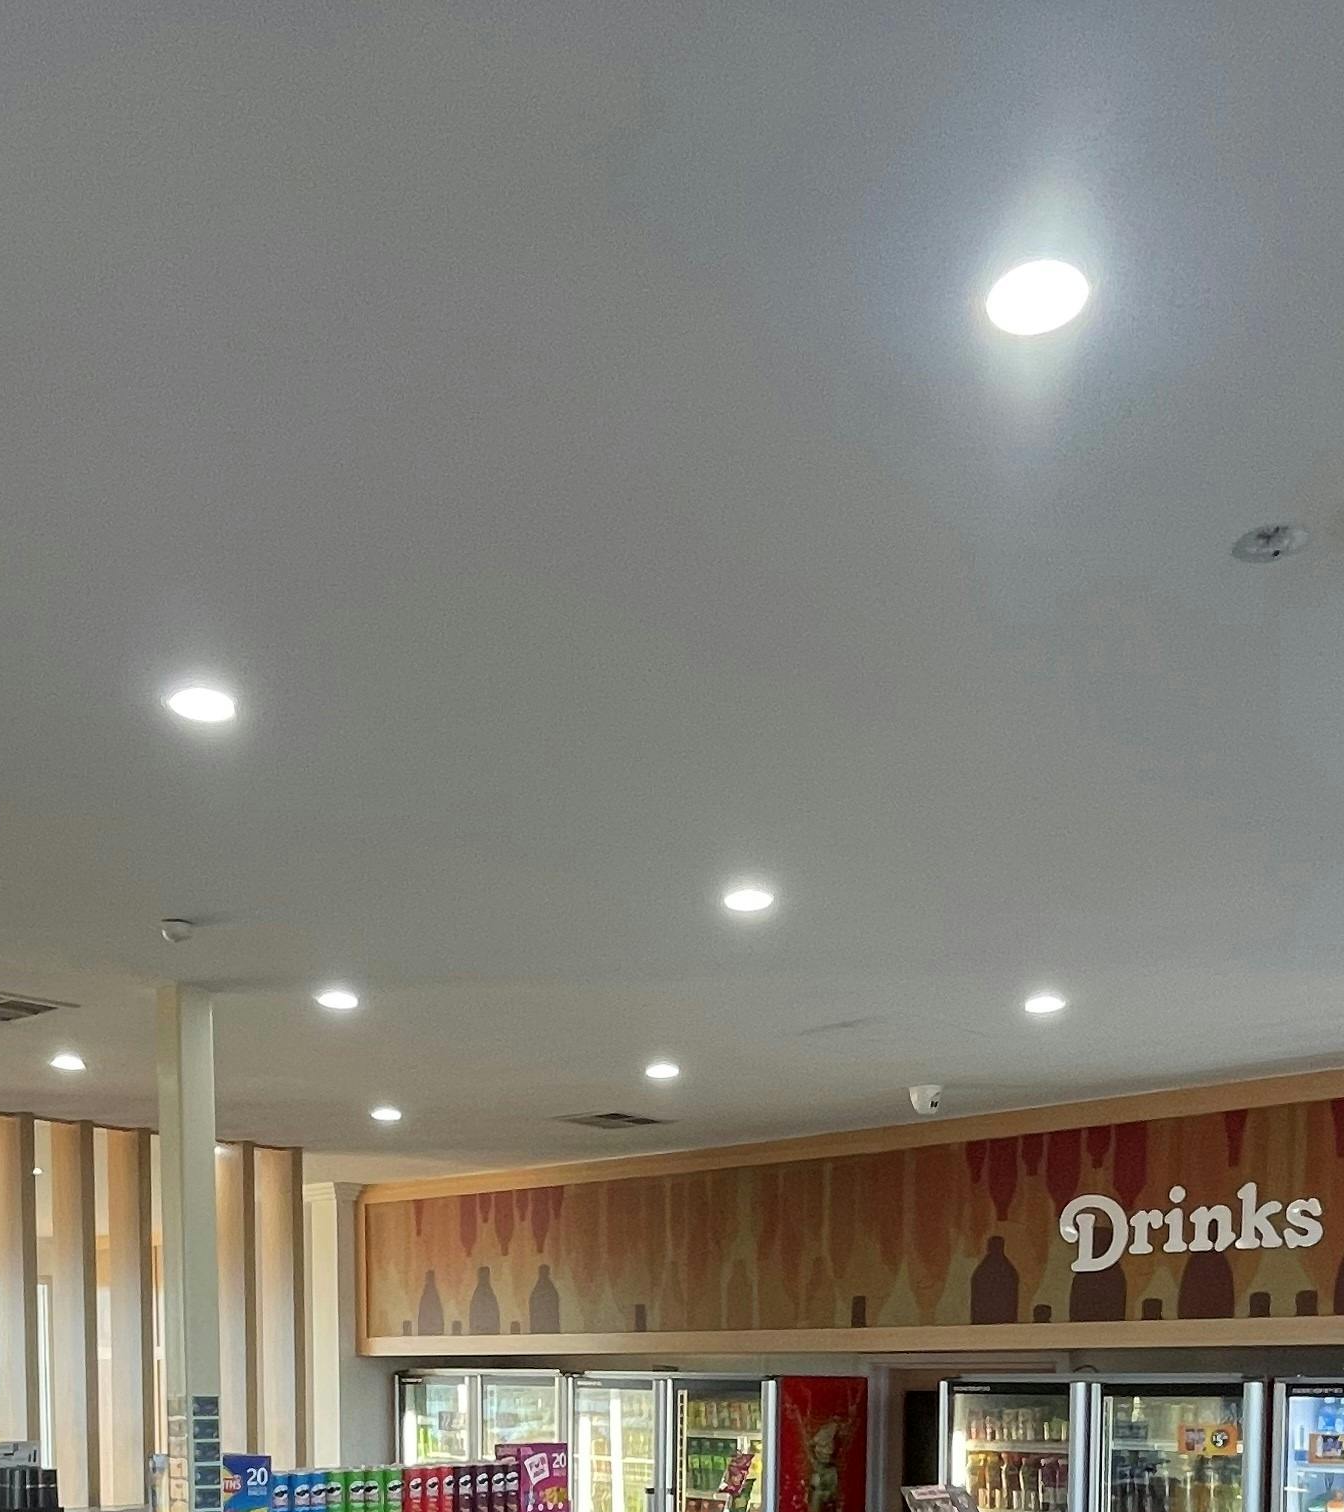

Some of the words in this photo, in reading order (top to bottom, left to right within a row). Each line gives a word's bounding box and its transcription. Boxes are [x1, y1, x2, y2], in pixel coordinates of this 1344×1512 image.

[1059, 1182, 1325, 1274] Drinks
[552, 1453, 567, 1468] 20
[246, 1467, 268, 1486] 20
